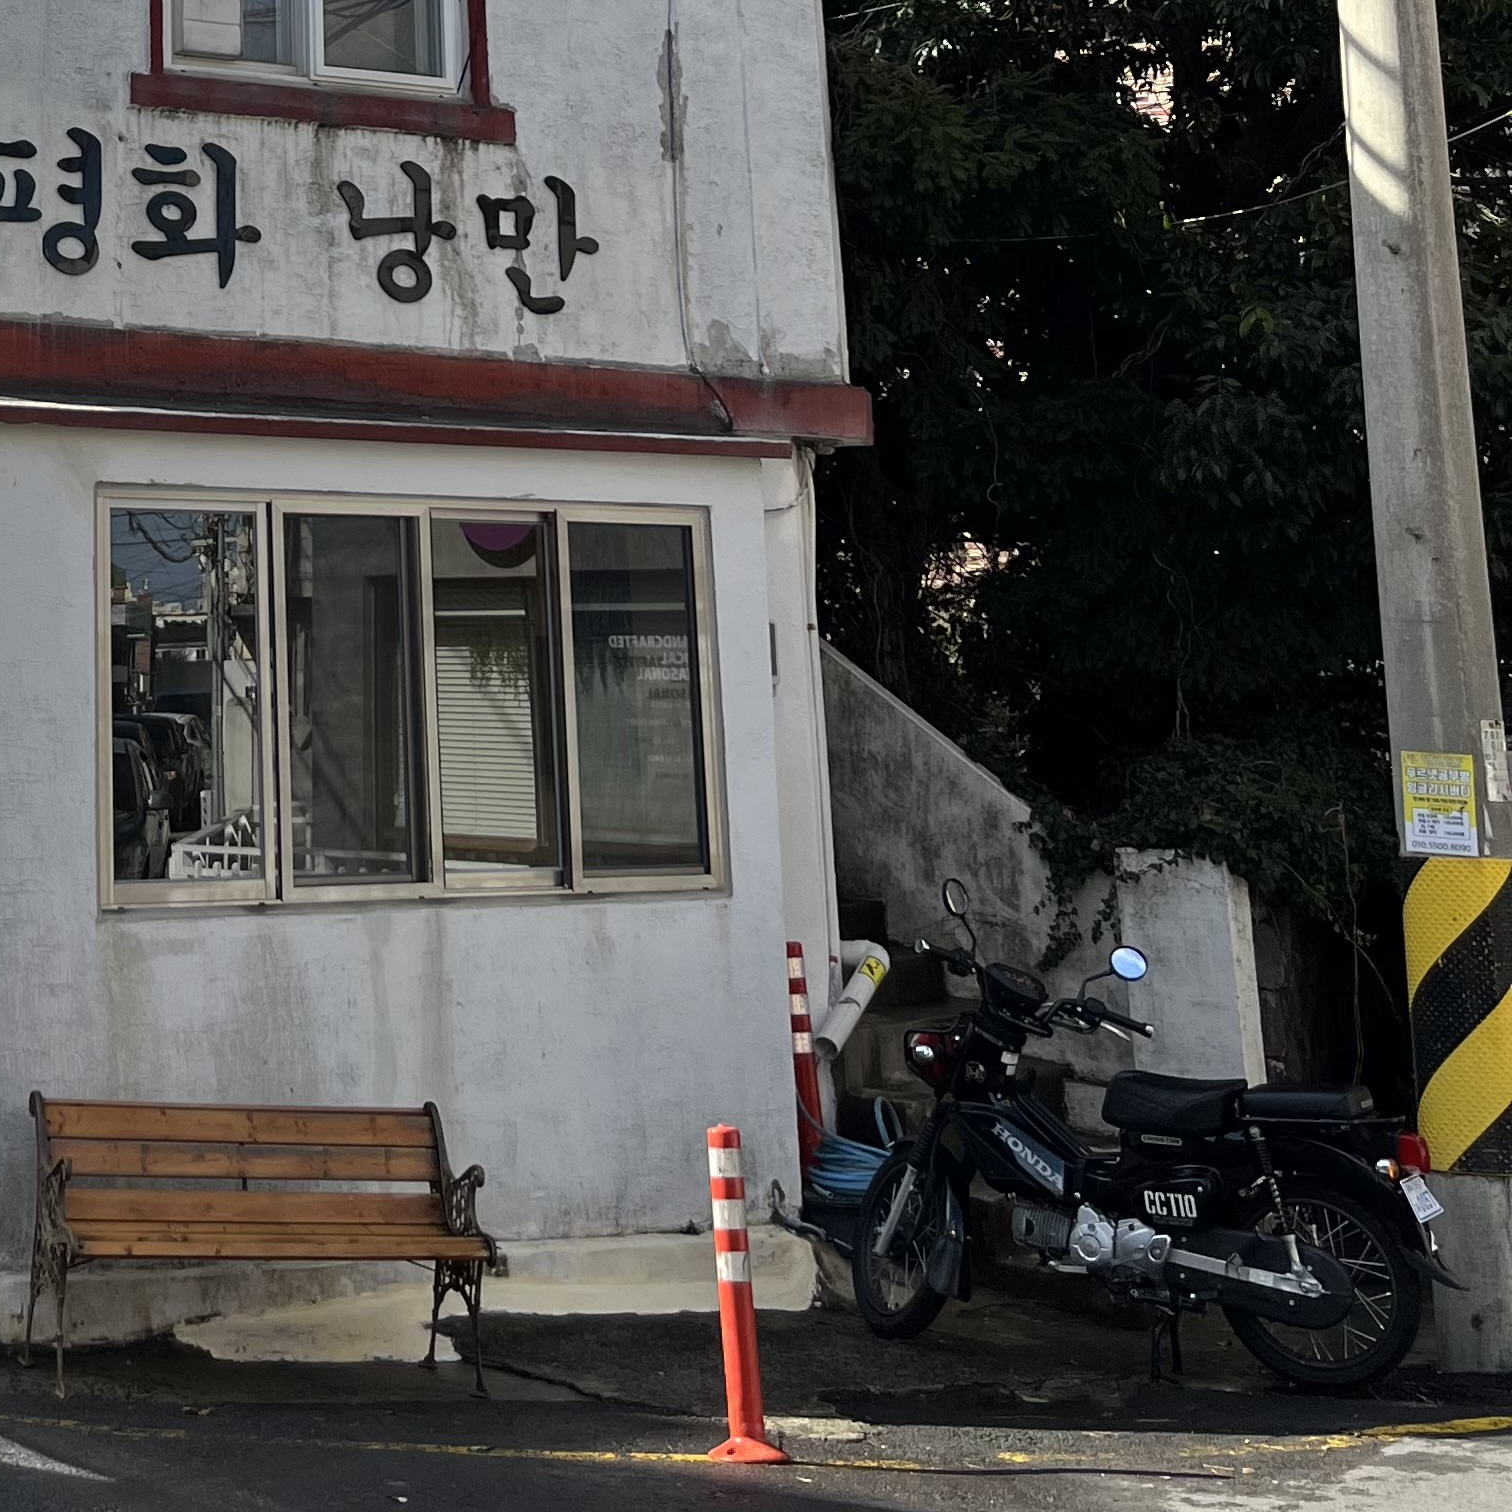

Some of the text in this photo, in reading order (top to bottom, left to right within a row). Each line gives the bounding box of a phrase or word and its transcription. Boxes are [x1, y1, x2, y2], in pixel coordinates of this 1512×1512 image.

[336, 160, 600, 314] 낭만
[990, 1121, 1064, 1190] HONDA
[1144, 1189, 1198, 1219] CC110
